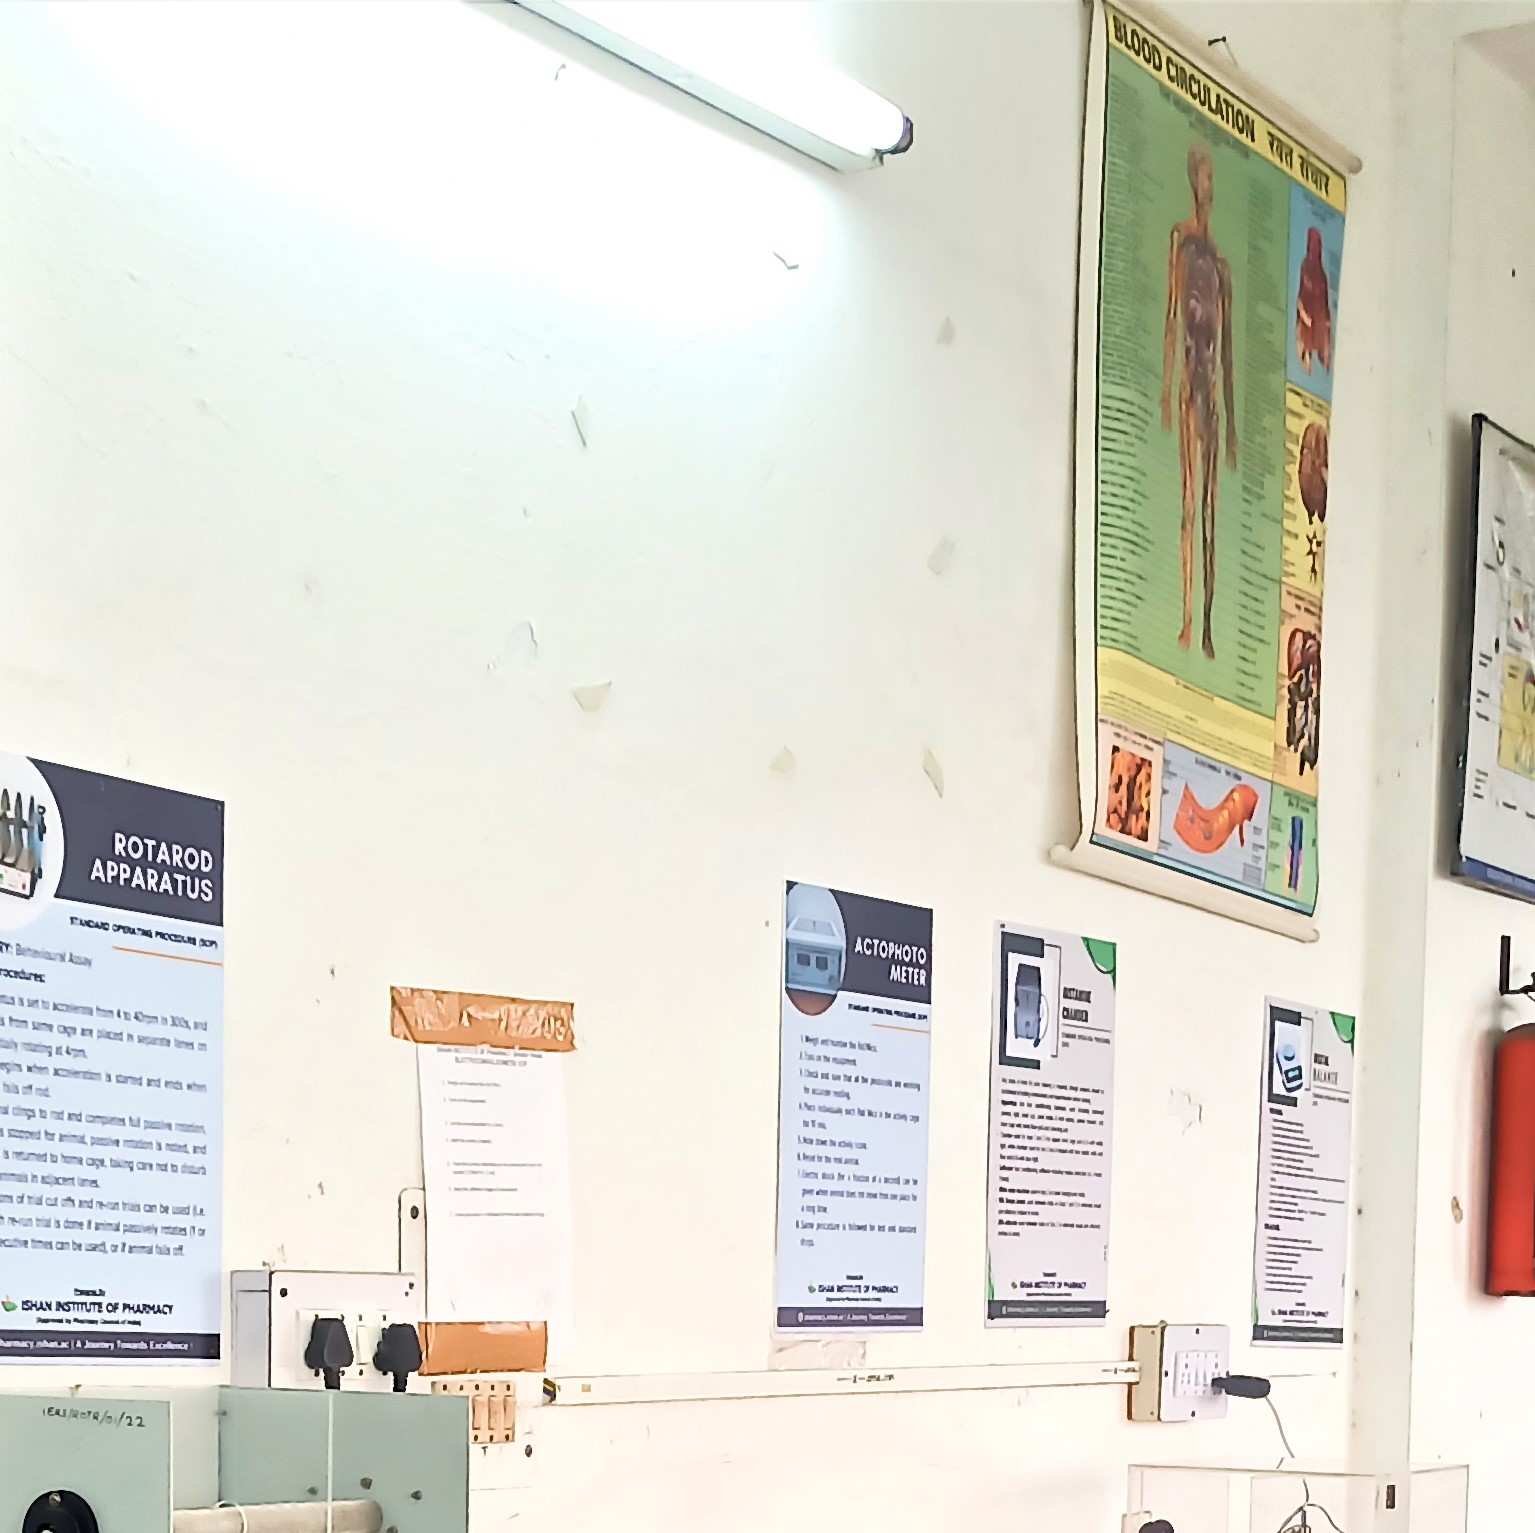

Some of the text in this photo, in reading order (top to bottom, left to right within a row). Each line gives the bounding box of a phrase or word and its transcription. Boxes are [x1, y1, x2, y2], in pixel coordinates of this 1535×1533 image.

[1112, 14, 1255, 143] BLOOD CIRCULATION
[115, 832, 213, 872] ROTAROD
[91, 858, 213, 902] APPARATUS
[855, 936, 926, 964] ACTOPHOTO
[890, 964, 926, 986] METER
[55, 1301, 103, 1313] INSTITUTE
[106, 1302, 119, 1313] OF
[122, 1303, 173, 1315] PHARMACY
